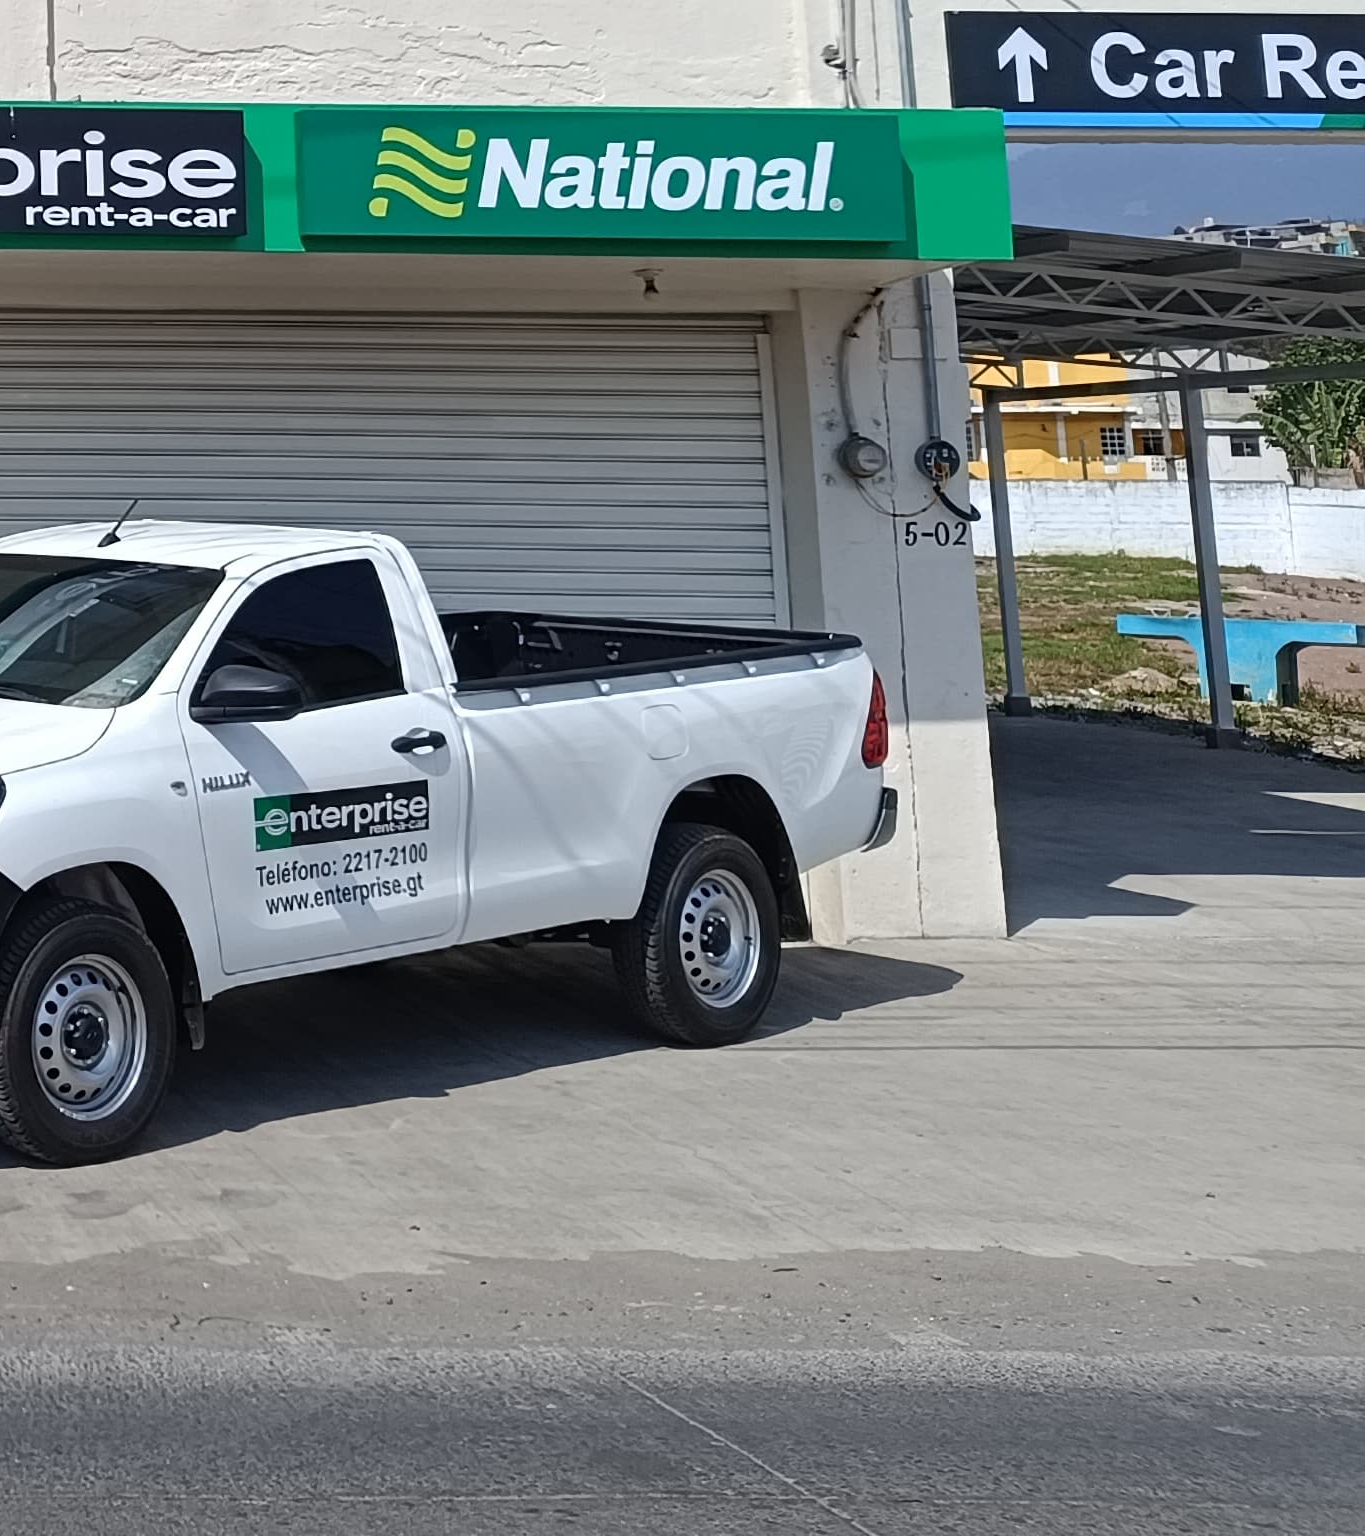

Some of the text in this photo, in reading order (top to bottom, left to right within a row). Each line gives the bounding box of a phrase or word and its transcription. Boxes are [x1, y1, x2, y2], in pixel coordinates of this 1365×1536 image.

[1090, 31, 1236, 99] Car
[477, 137, 835, 212] National
[25, 202, 237, 229] rent-a-car
[904, 521, 968, 547] 5-02
[201, 771, 251, 793] HILUX
[254, 793, 428, 836] enterprise
[369, 818, 428, 835] rent-a-car
[256, 842, 428, 888] Teléfono: 2217-2100
[266, 872, 424, 915] www.enterprise.gt
